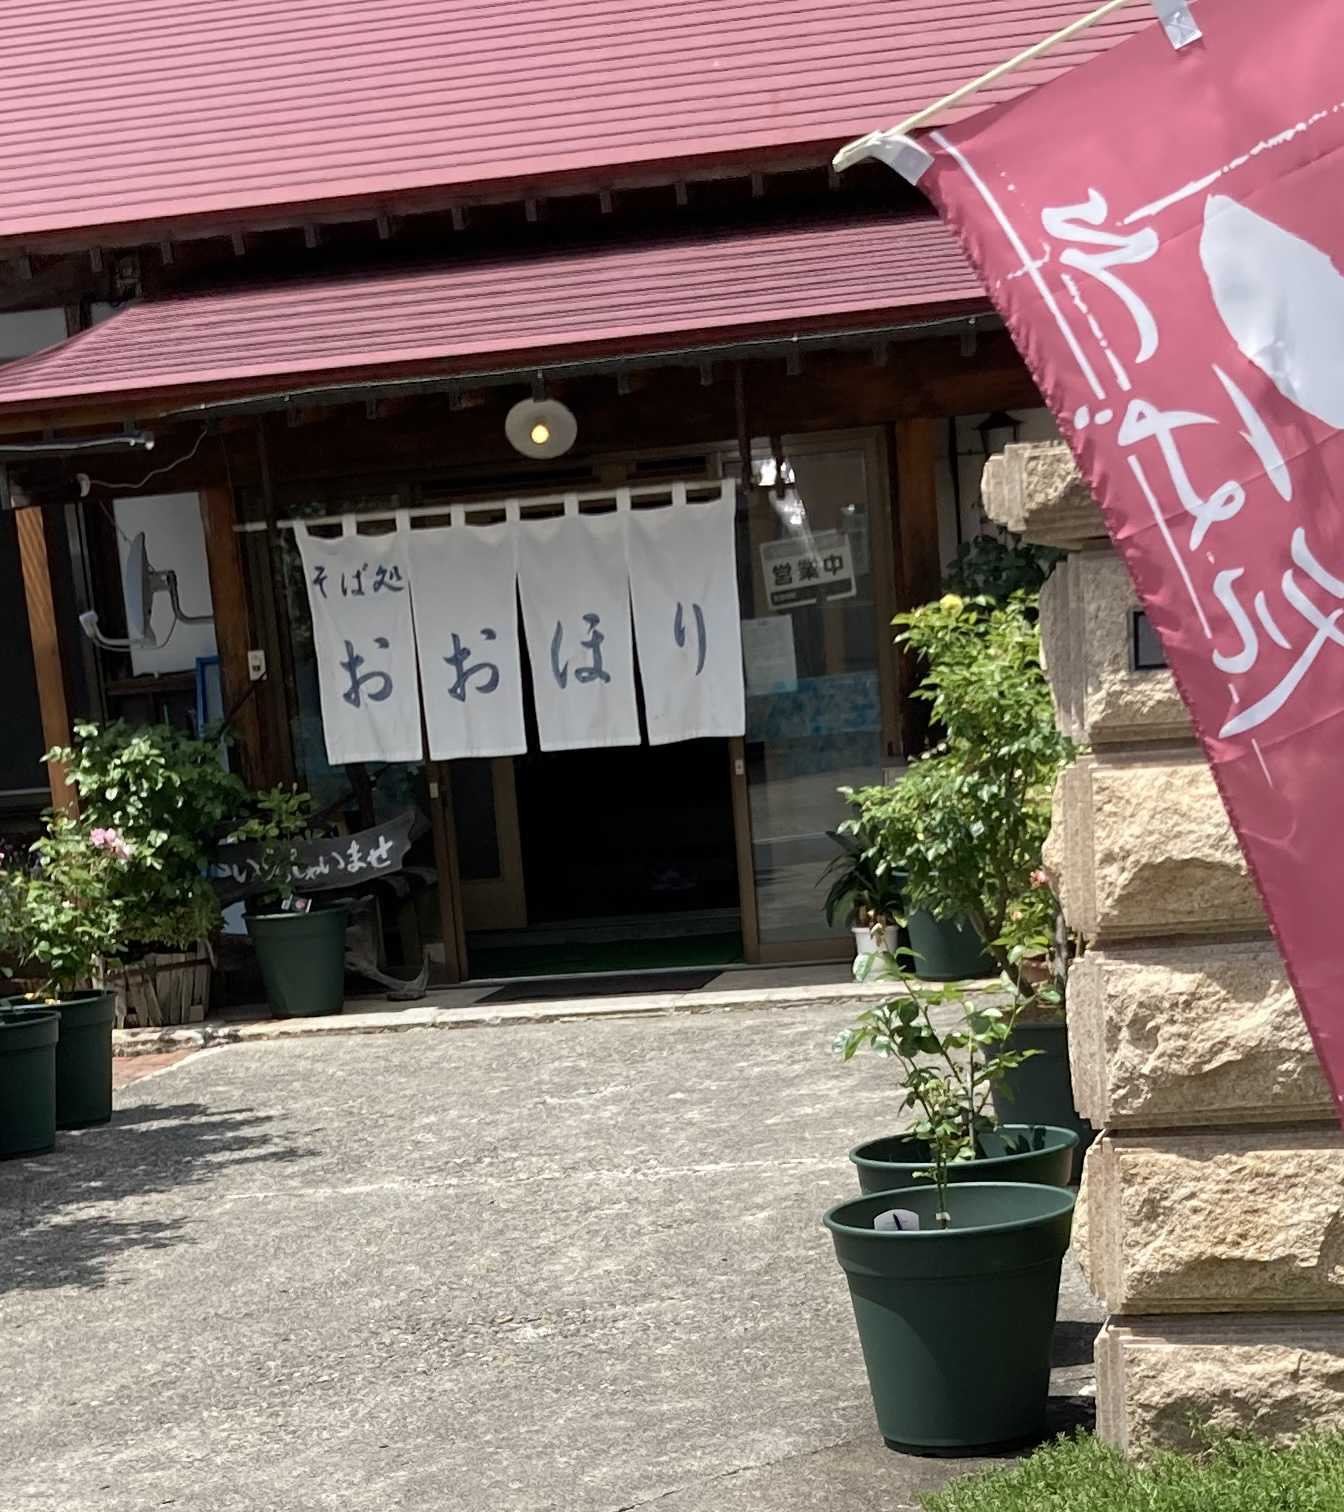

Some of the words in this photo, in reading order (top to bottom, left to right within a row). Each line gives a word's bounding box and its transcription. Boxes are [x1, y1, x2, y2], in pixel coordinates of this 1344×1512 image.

[313, 562, 405, 599] そば処
[771, 553, 844, 587] 営業中
[339, 601, 707, 708] おおほり
